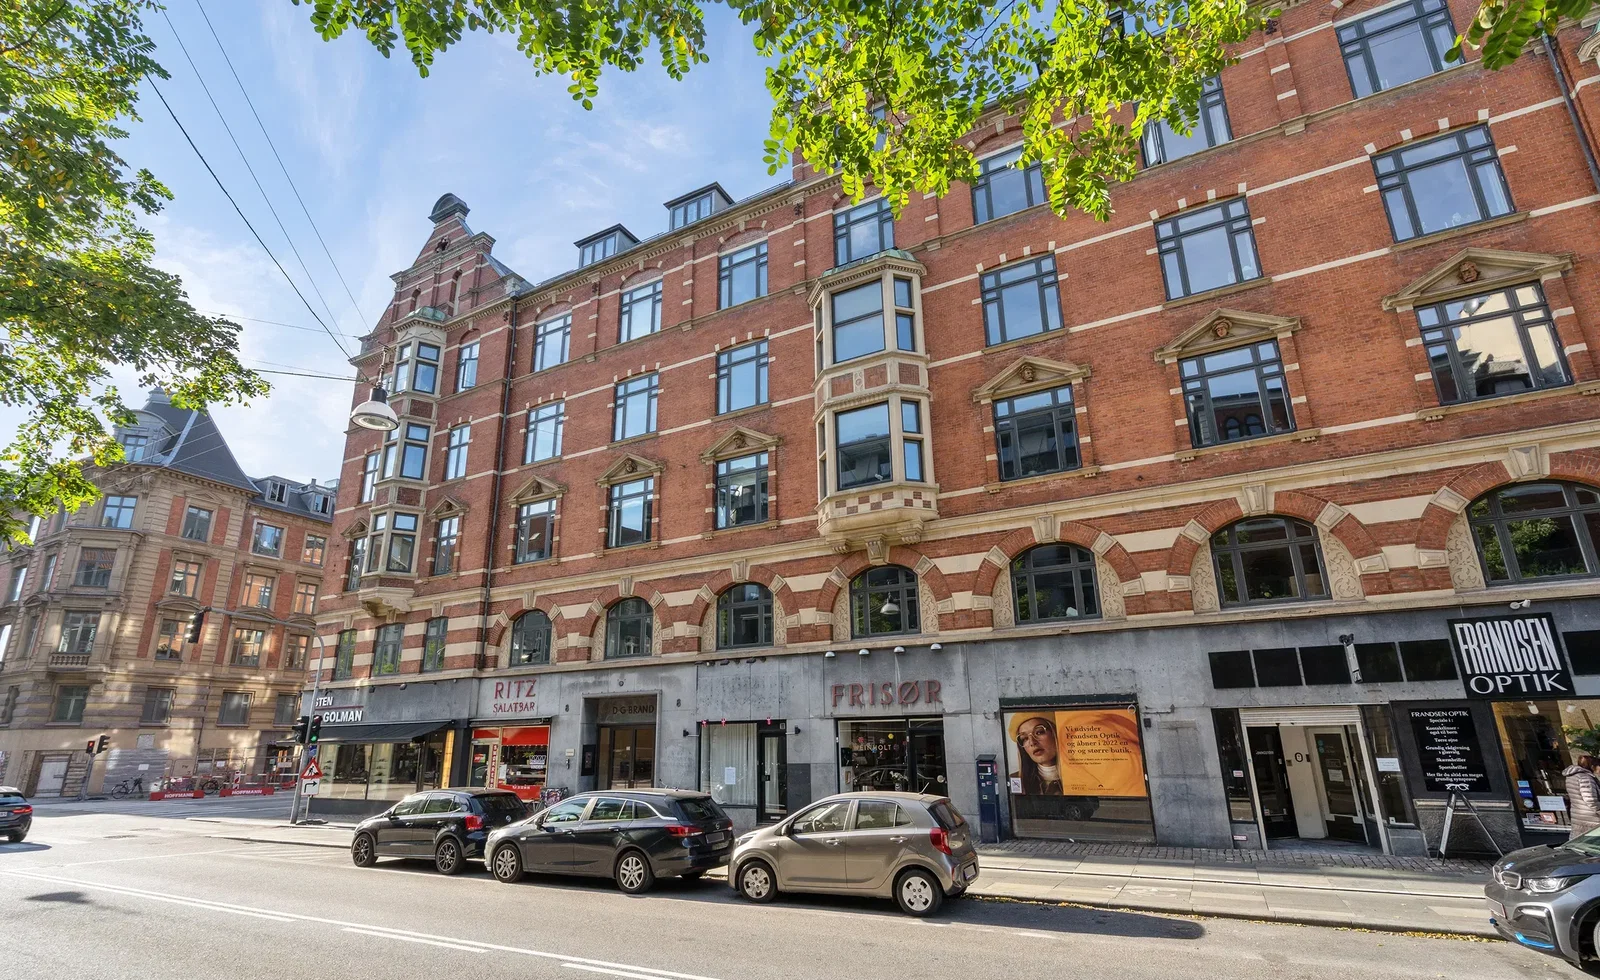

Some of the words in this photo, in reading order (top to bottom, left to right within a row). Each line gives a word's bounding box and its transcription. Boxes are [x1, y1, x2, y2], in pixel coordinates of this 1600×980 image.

[1454, 617, 1562, 675] FRANDSEN
[494, 679, 537, 699] RITZ
[1469, 672, 1568, 694] OPTIK
[831, 680, 942, 707] FRISØR
[493, 702, 535, 713] SALATBAR
[628, 705, 655, 714] BRAND
[676, 698, 681, 707] 8
[323, 710, 362, 722] GOLMAN
